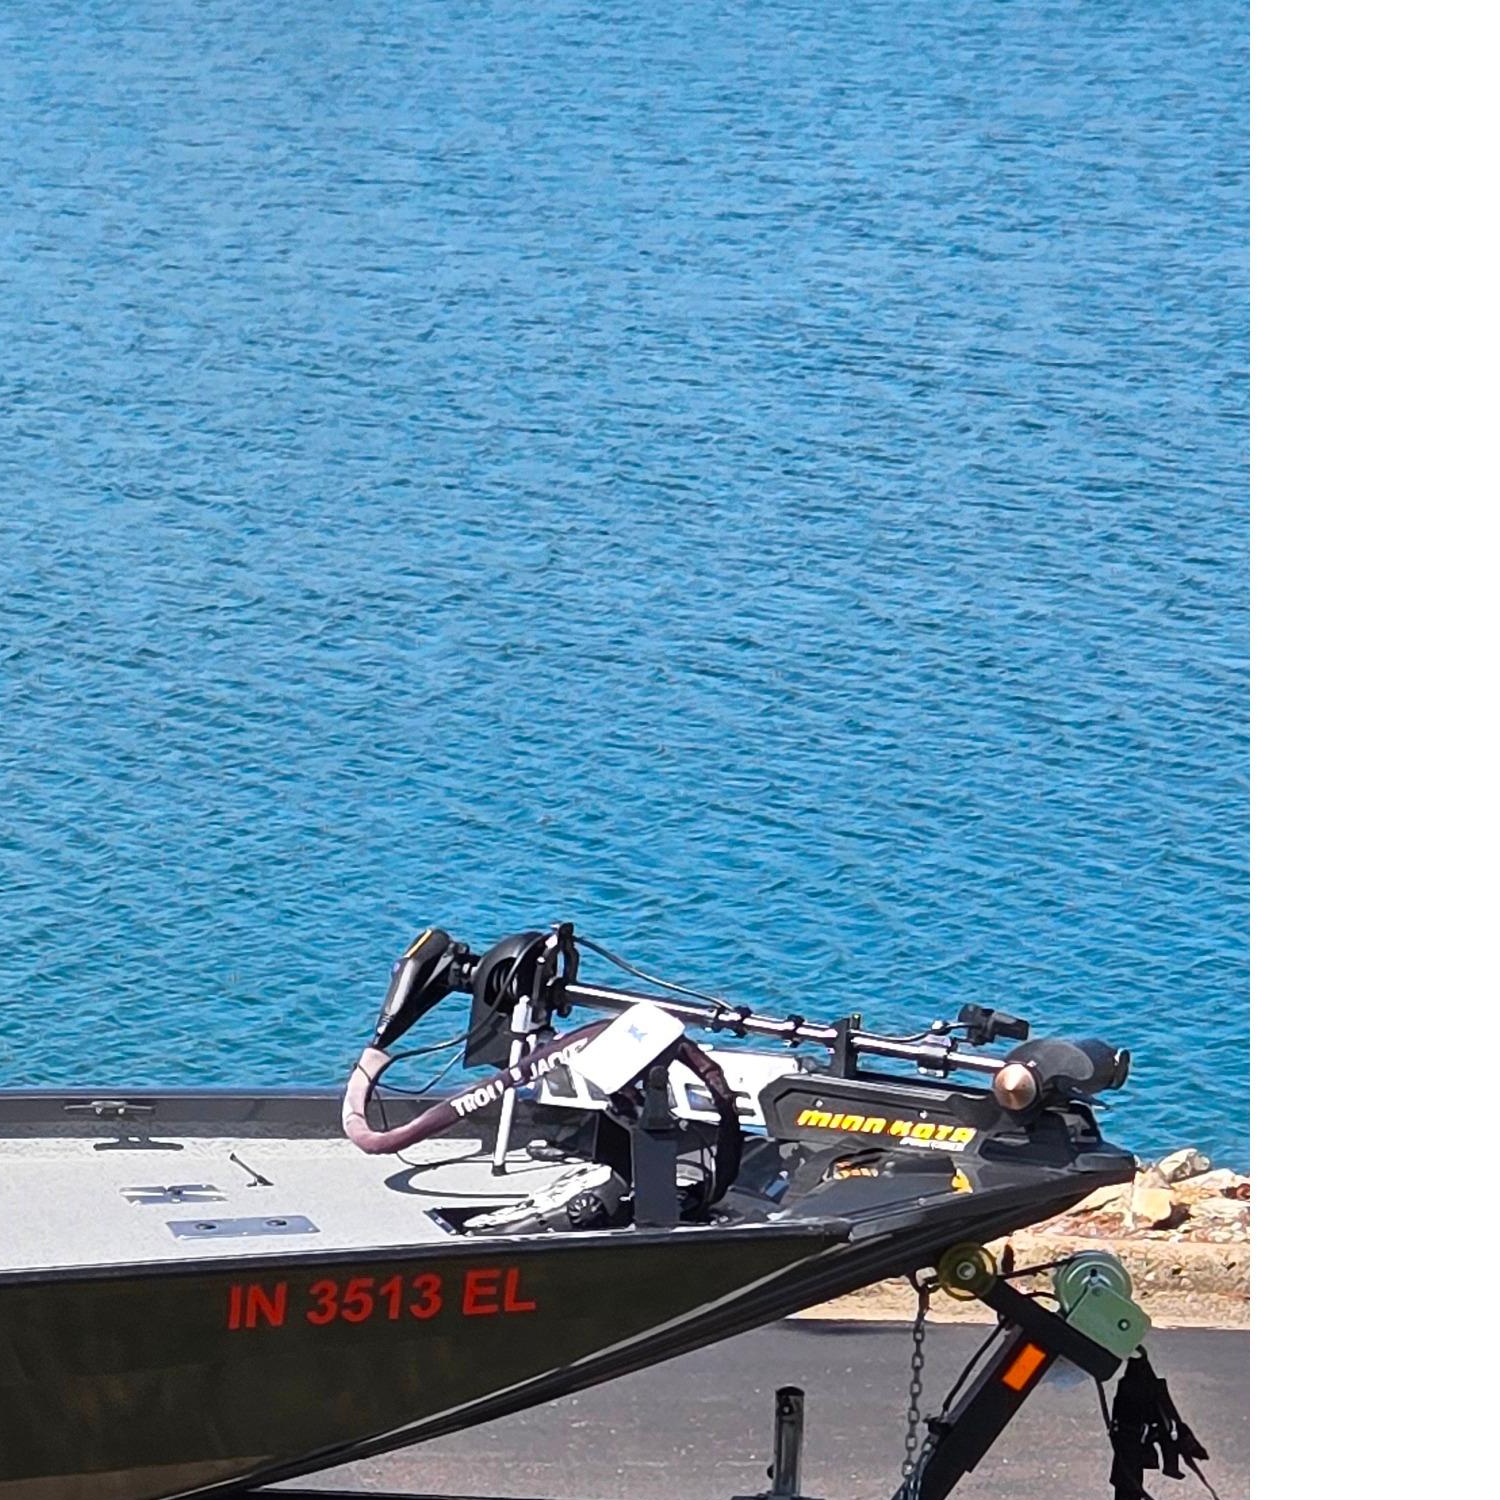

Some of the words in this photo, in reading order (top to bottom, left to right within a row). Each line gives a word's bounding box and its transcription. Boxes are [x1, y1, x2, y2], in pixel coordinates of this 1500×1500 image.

[228, 1281, 287, 1329] IN
[306, 1274, 442, 1325] 3513
[462, 1267, 536, 1315] EL
